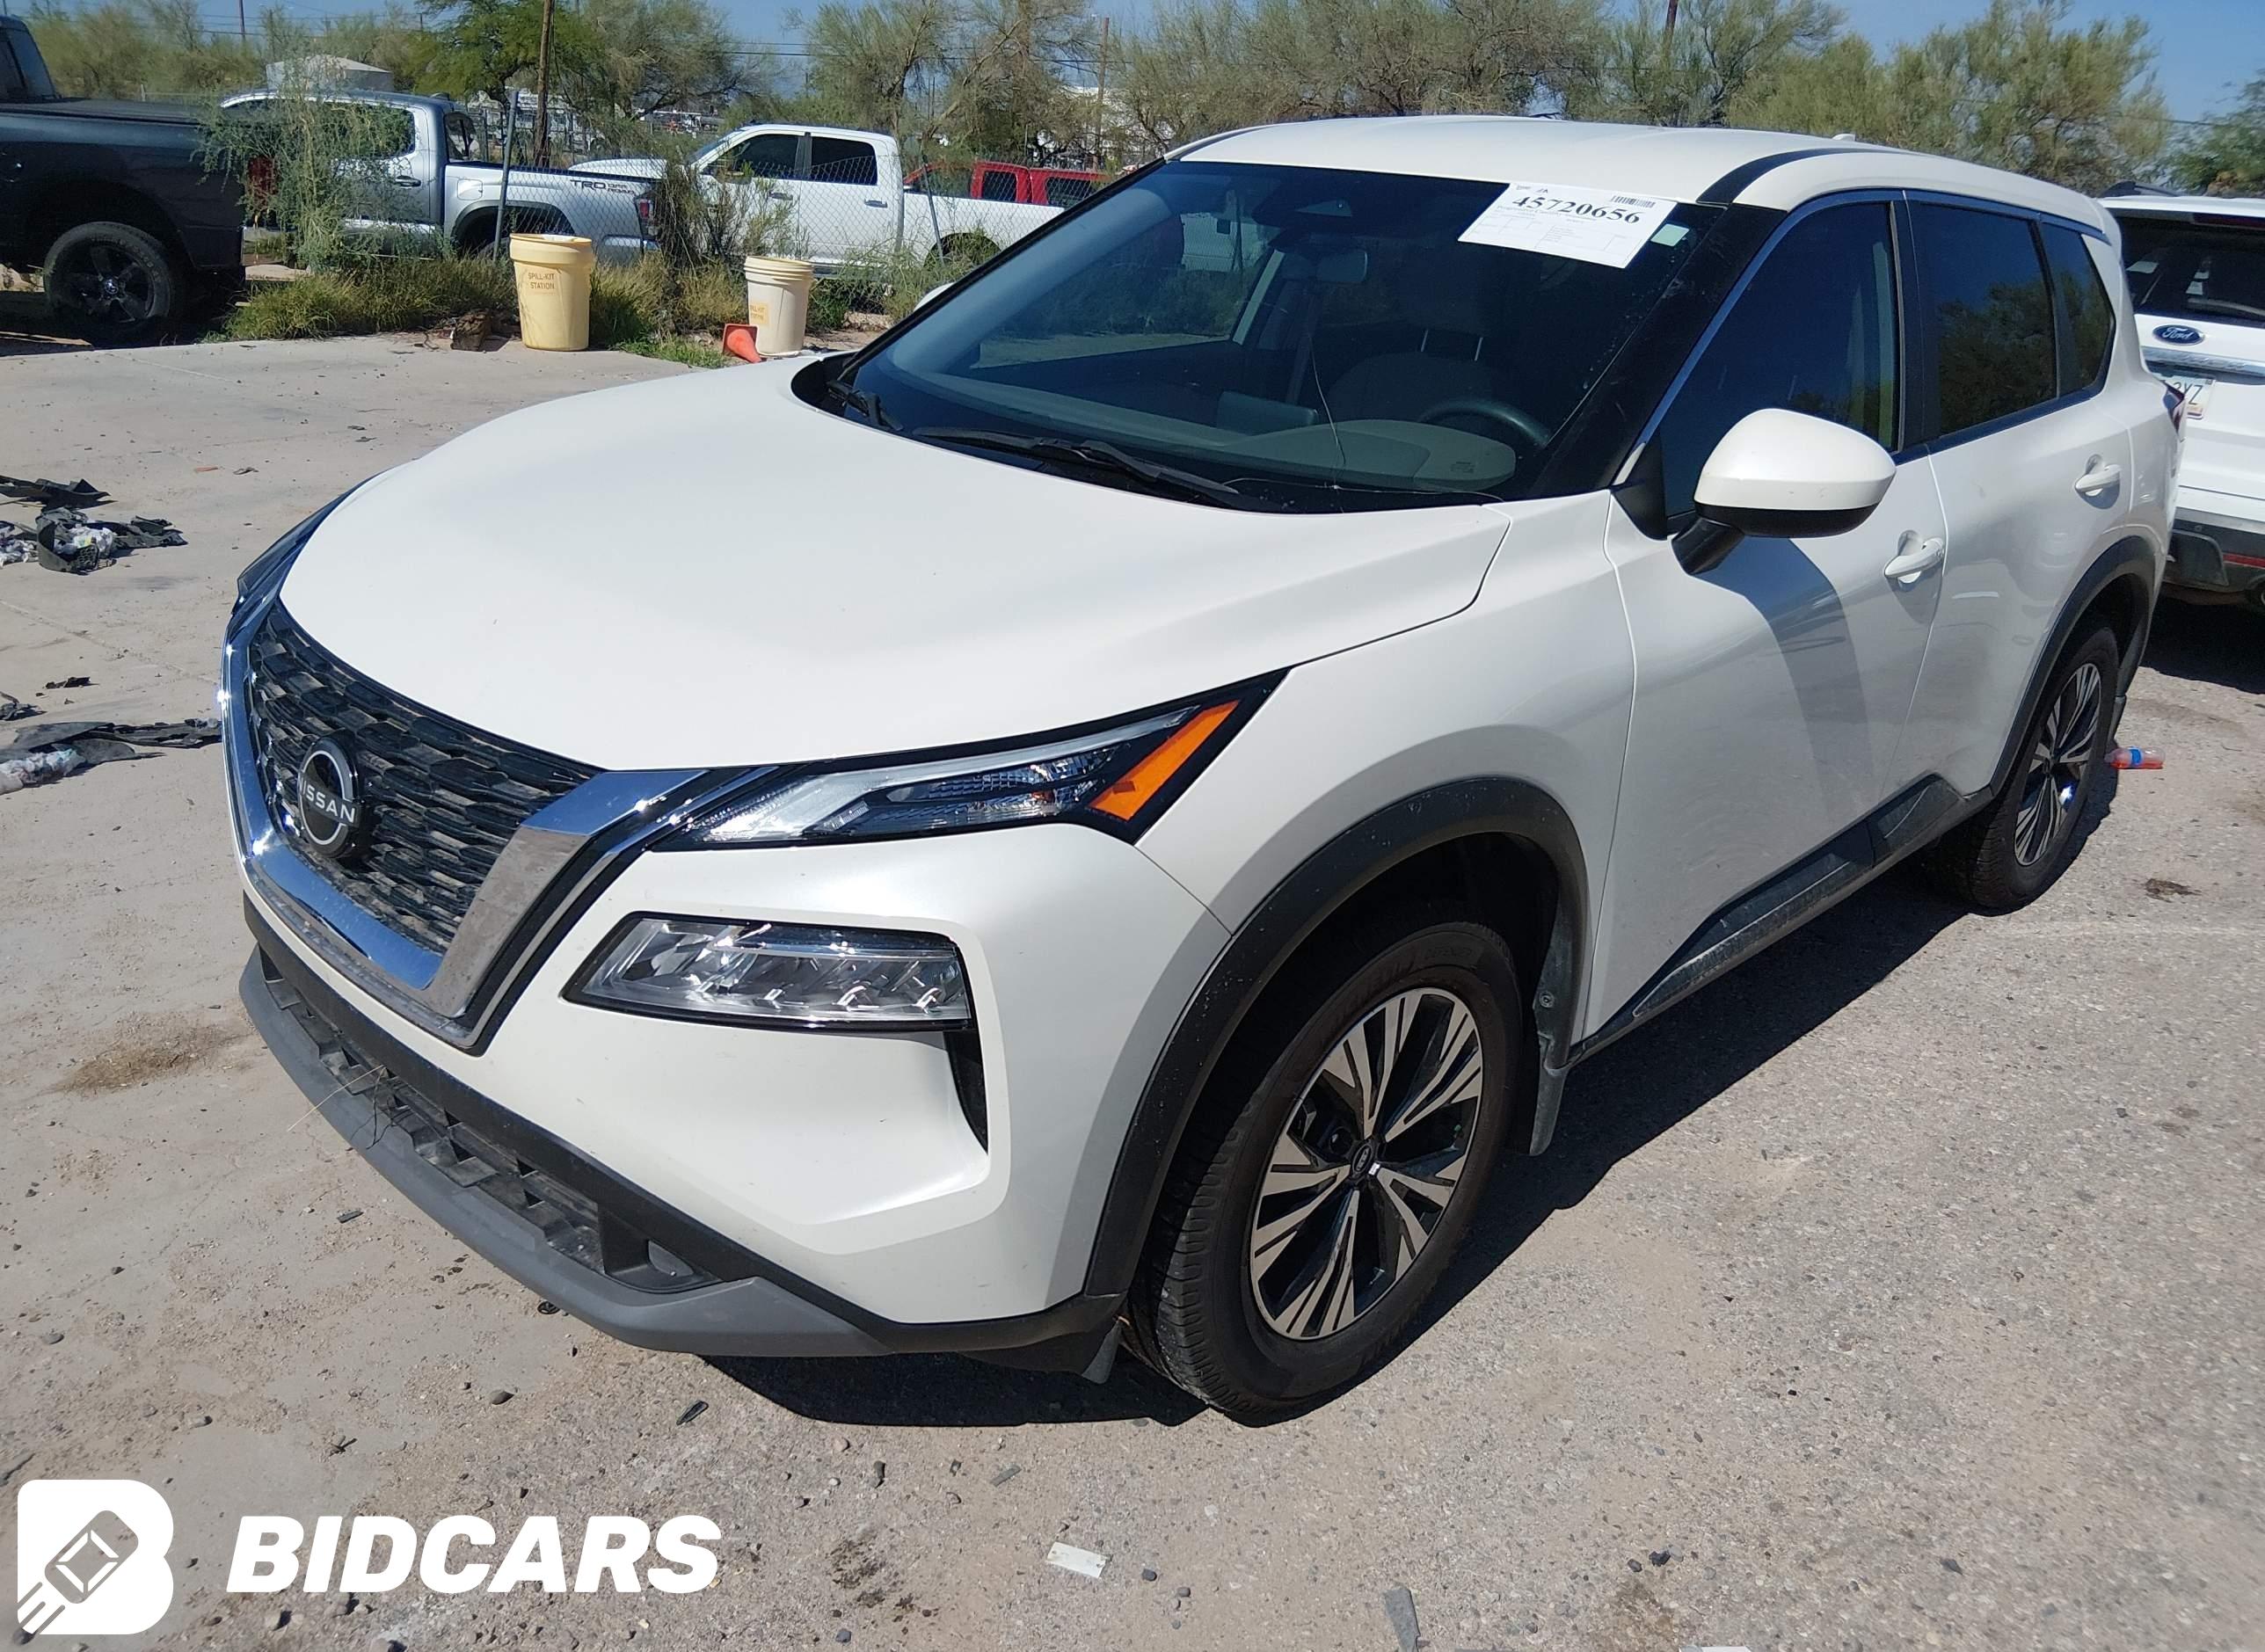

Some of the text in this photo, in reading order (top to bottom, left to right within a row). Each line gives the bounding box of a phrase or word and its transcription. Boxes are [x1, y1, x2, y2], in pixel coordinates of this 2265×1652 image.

[570, 179, 607, 191] TRD
[1512, 196, 1645, 223] 45720656
[528, 272, 555, 280] SPILL-KIT
[2161, 326, 2195, 340] Ford
[299, 775, 356, 824] NISSAN
